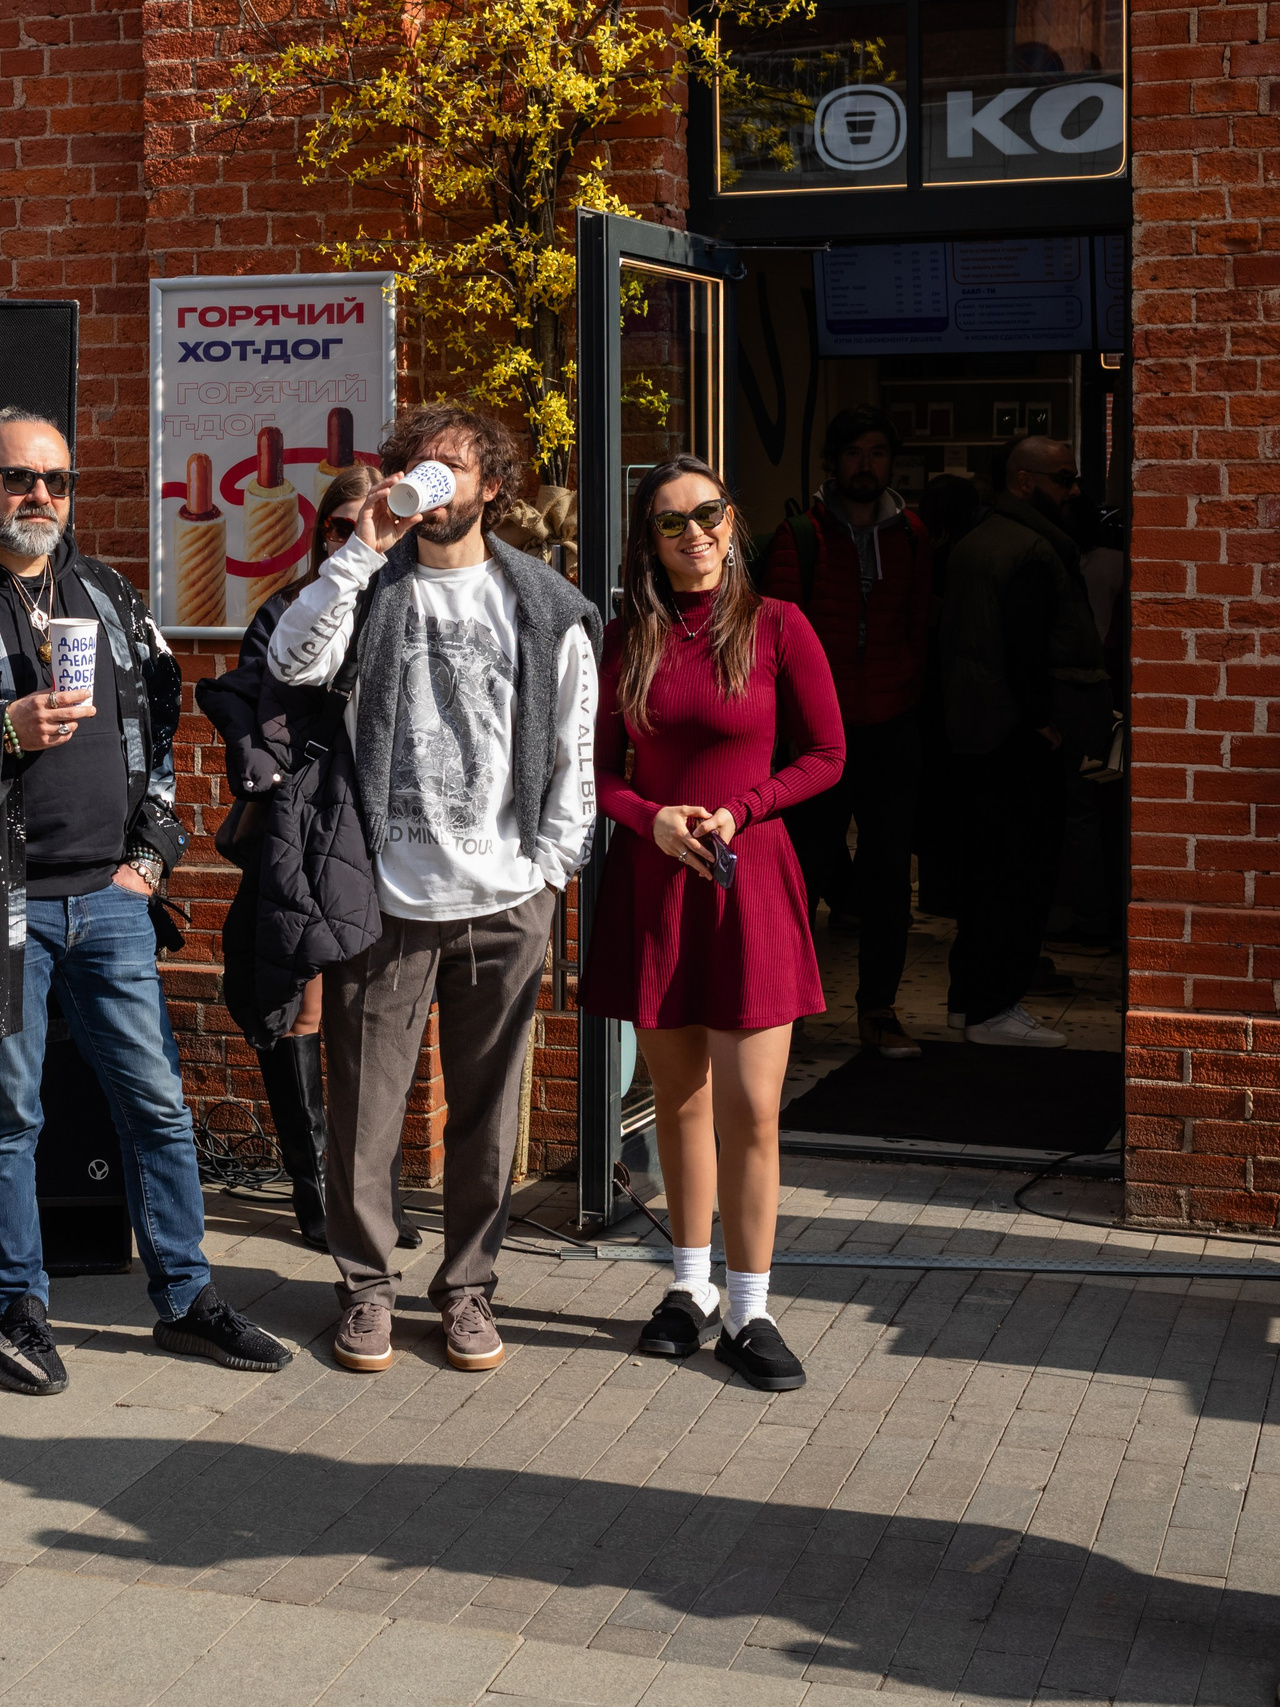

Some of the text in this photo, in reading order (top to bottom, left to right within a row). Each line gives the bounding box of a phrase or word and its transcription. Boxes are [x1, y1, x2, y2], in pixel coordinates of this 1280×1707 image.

[177, 297, 365, 328] ГОРЯЧИЙ
[177, 338, 343, 365] ХОТ-ДОГ
[177, 374, 367, 405] ГОРЯЧИЙ
[162, 413, 276, 441] Т-ДОГ
[577, 723, 593, 772] ALL
[581, 780, 595, 816] BE
[452, 836, 494, 856] TOUR
